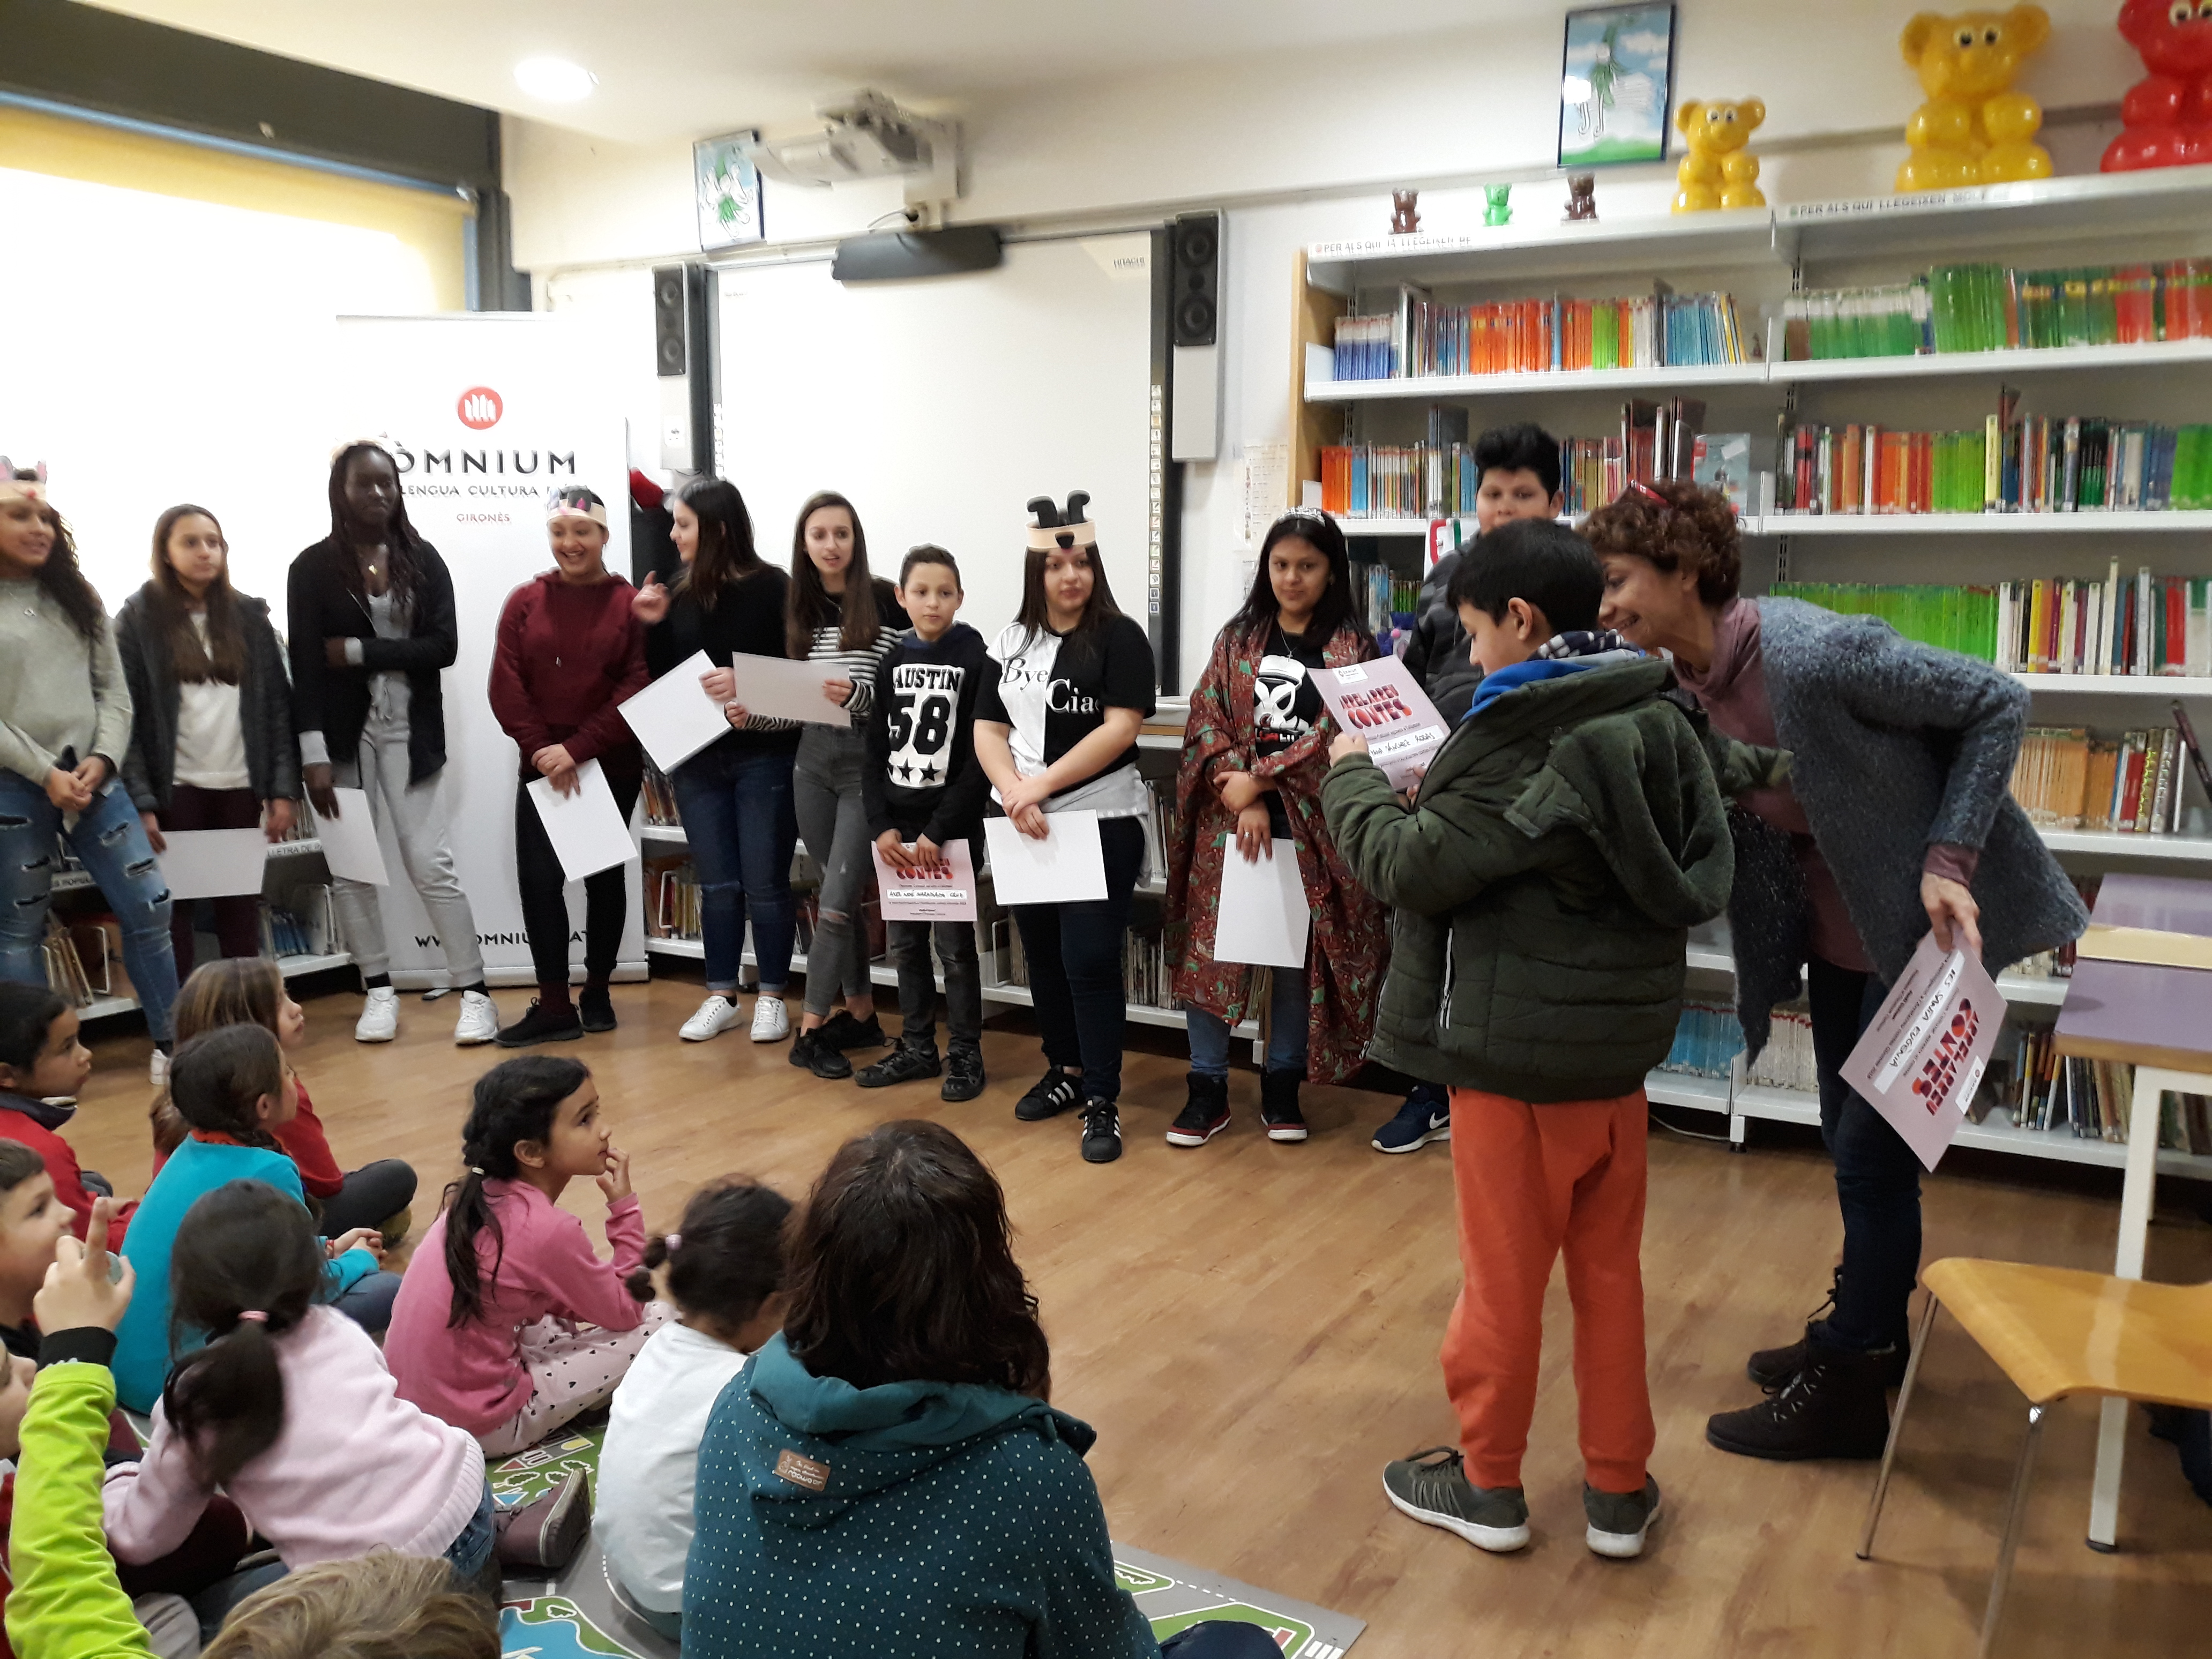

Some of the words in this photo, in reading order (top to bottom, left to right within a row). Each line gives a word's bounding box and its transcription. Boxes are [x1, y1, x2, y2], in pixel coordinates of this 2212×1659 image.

[1324, 243, 1342, 252] PER
[400, 485, 460, 495] LENGUA
[468, 485, 539, 496] CULTURA
[456, 512, 511, 522] GIRONÈS
[893, 667, 961, 692] AUSTIN
[1000, 658, 1048, 691] Bye
[1045, 678, 1100, 714] Cia
[889, 693, 951, 755] 58
[1347, 699, 1413, 729] CONTES
[1922, 991, 1944, 1021] SANTA
[1911, 998, 1972, 1098] CONTES
